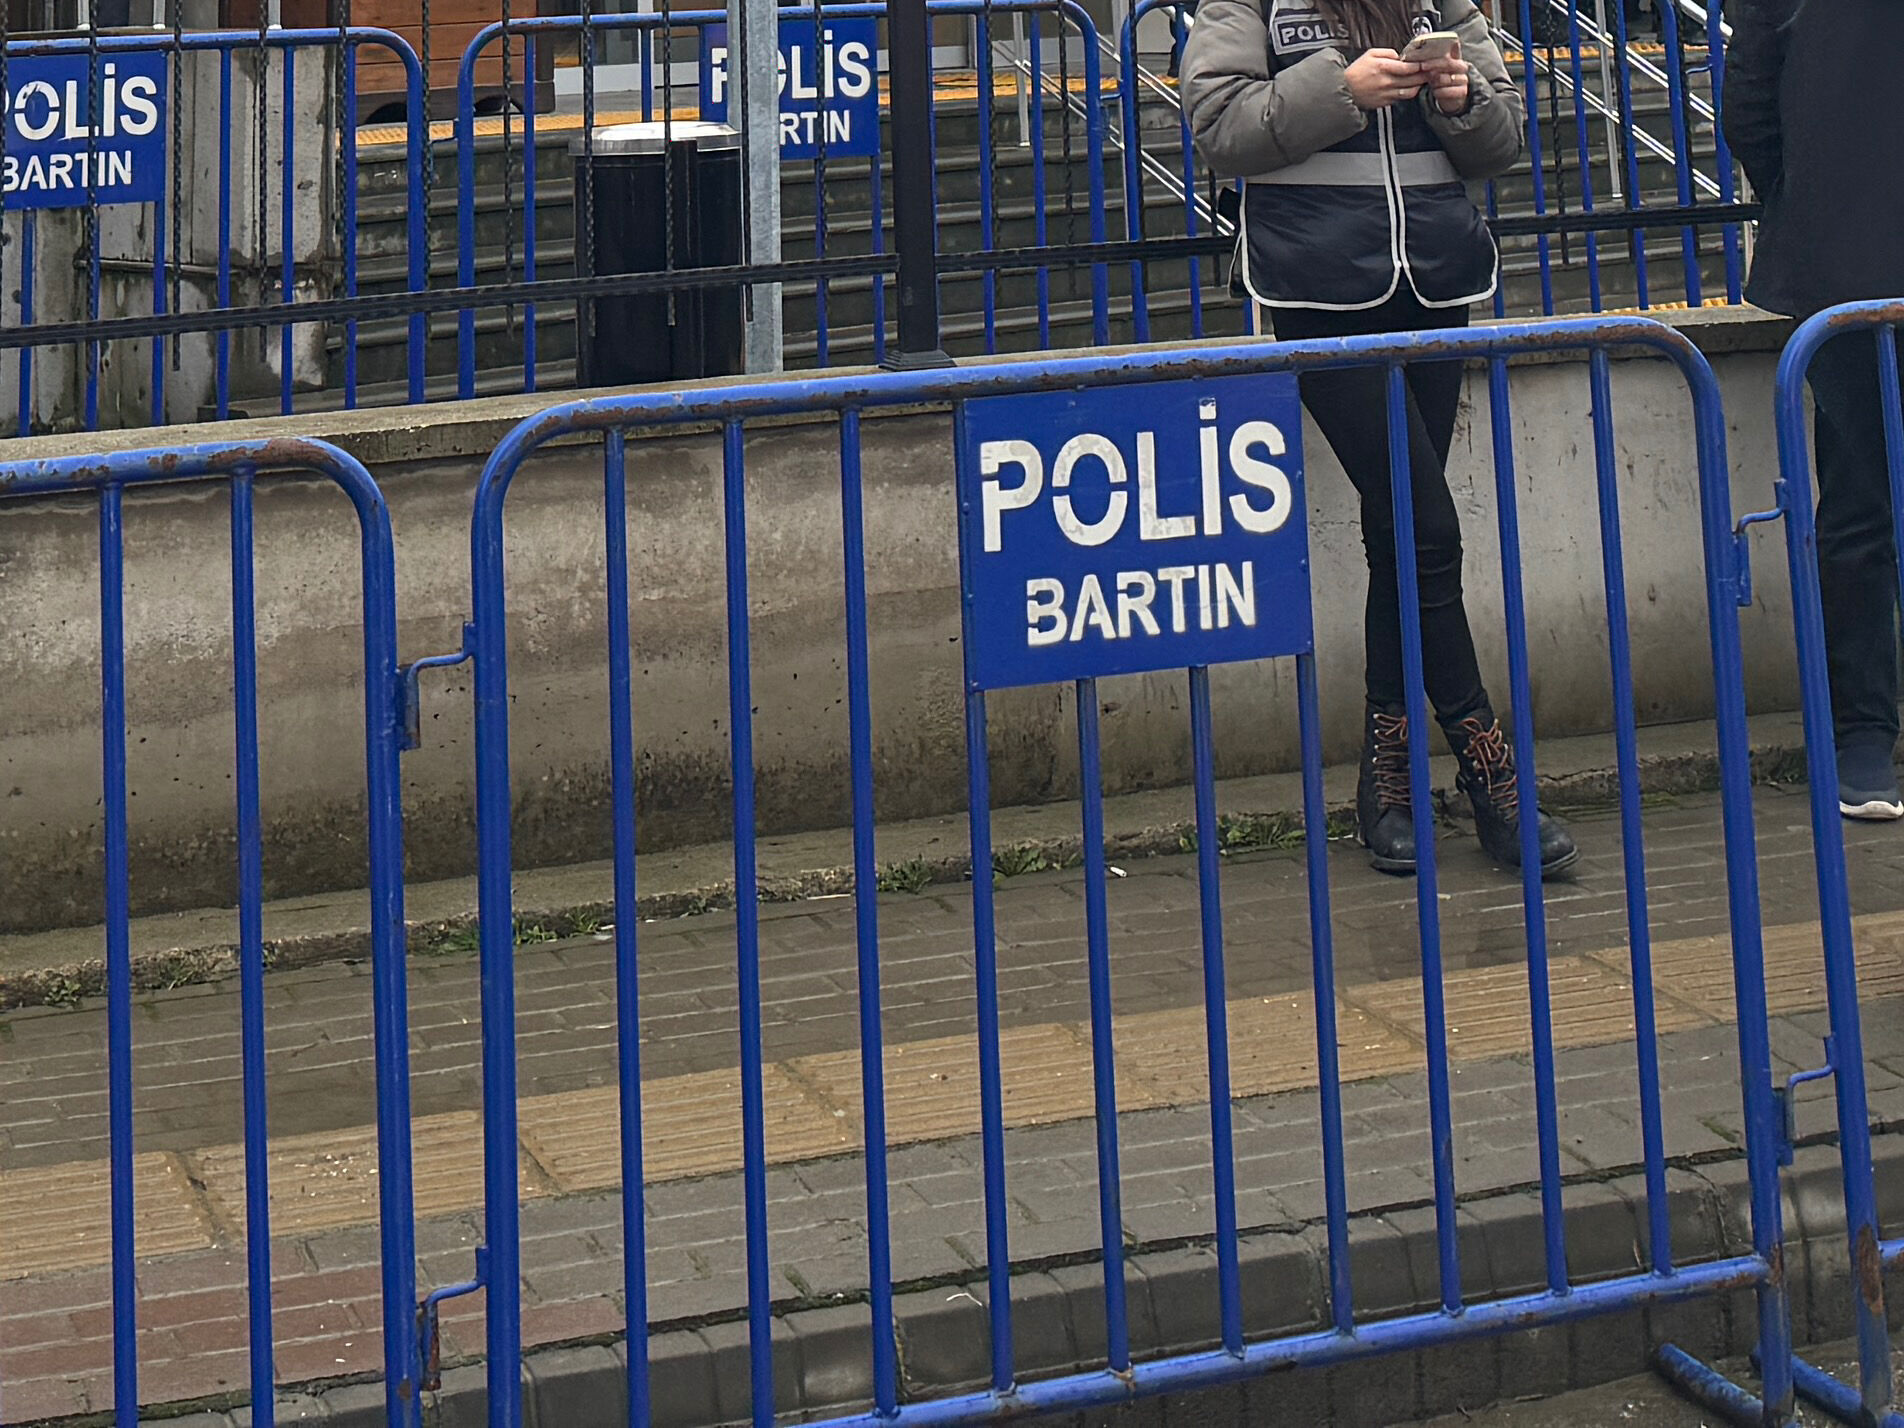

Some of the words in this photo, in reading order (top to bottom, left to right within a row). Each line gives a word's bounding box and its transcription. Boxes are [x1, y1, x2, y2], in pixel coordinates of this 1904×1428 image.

[711, 29, 872, 104] PLİS
[979, 397, 1293, 553] POLİS
[1026, 560, 1257, 647] BARTIN
